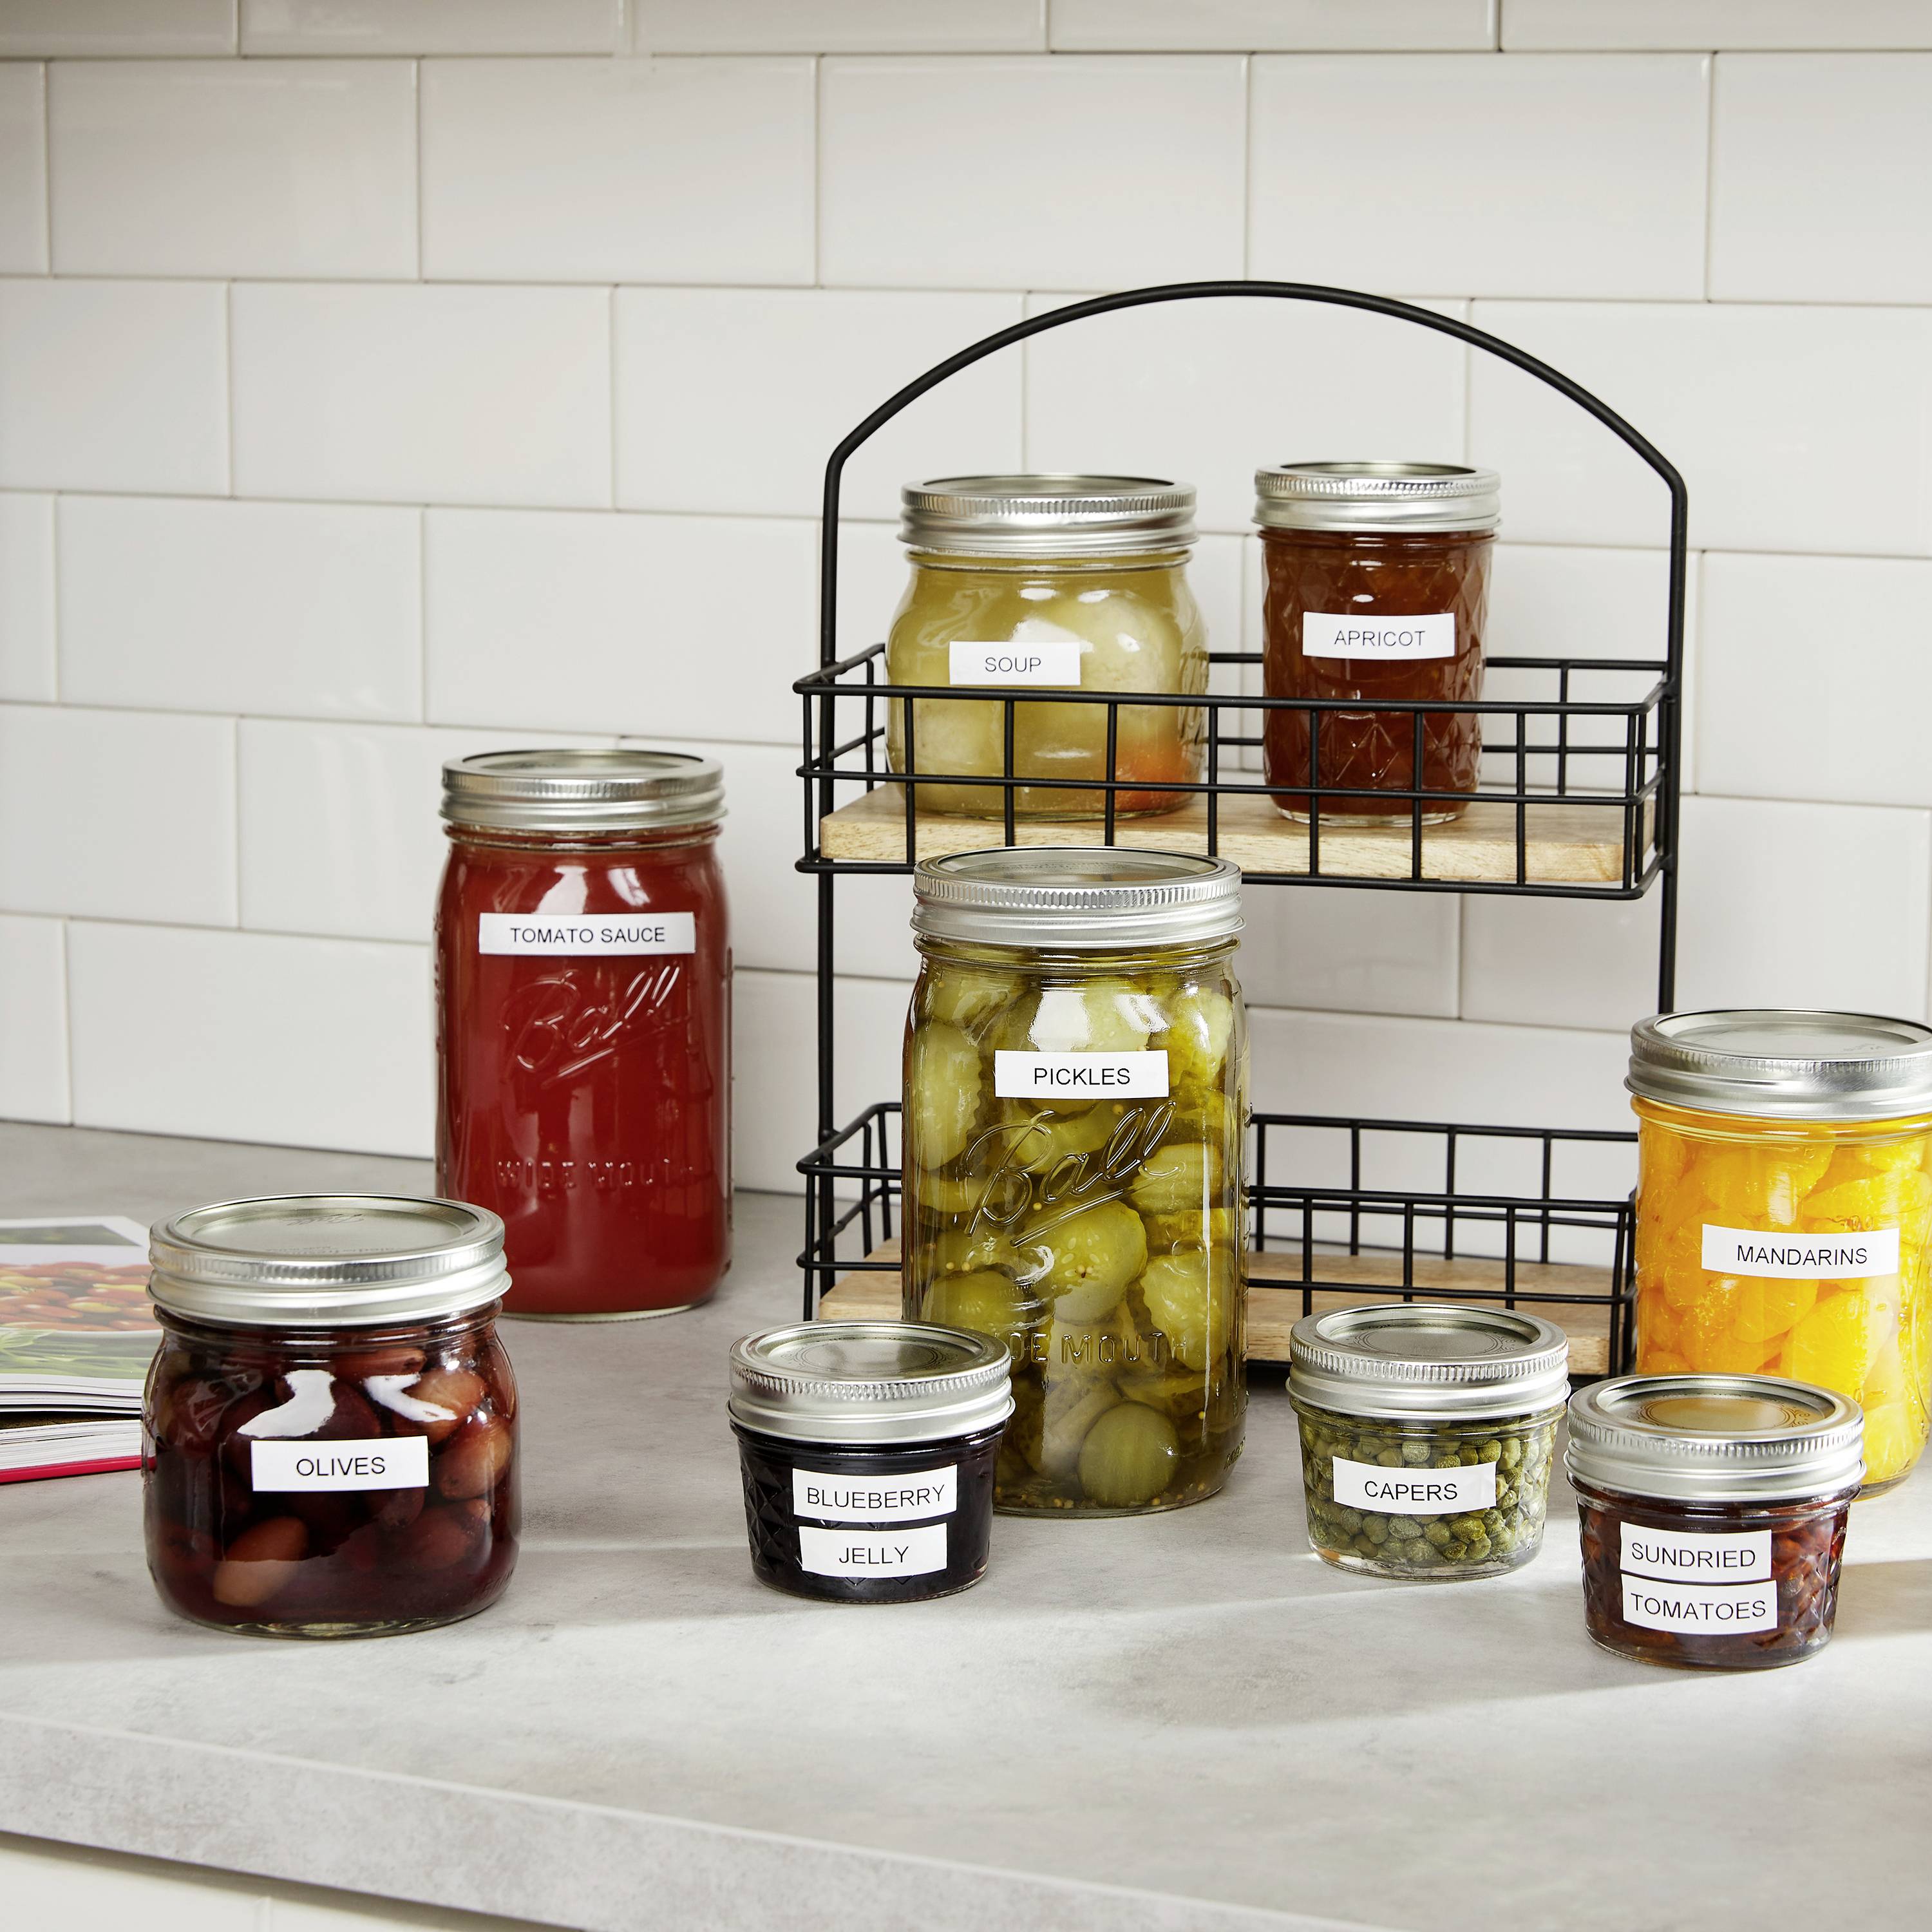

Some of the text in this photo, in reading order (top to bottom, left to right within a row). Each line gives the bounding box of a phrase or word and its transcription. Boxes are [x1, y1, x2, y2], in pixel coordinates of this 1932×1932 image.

[1334, 630, 1425, 647] APRICOT
[985, 657, 1041, 672] SOUP
[510, 927, 666, 944] TOMATO SAUCE
[502, 964, 688, 1082] Ball
[1034, 1068, 1130, 1085] PICKLES
[960, 1100, 1184, 1247] Ball
[1737, 1244, 1868, 1266] MANDARINS
[1009, 1332, 1188, 1363] DE MOUTH
[296, 1457, 386, 1477] OLIVES
[807, 1484, 945, 1510] BLUEBERRY
[1364, 1481, 1459, 1501] CAPERS
[838, 1546, 909, 1564] JELLY
[1631, 1542, 1756, 1568] SUNDRIED
[1631, 1593, 1766, 1621] TOMATOES
